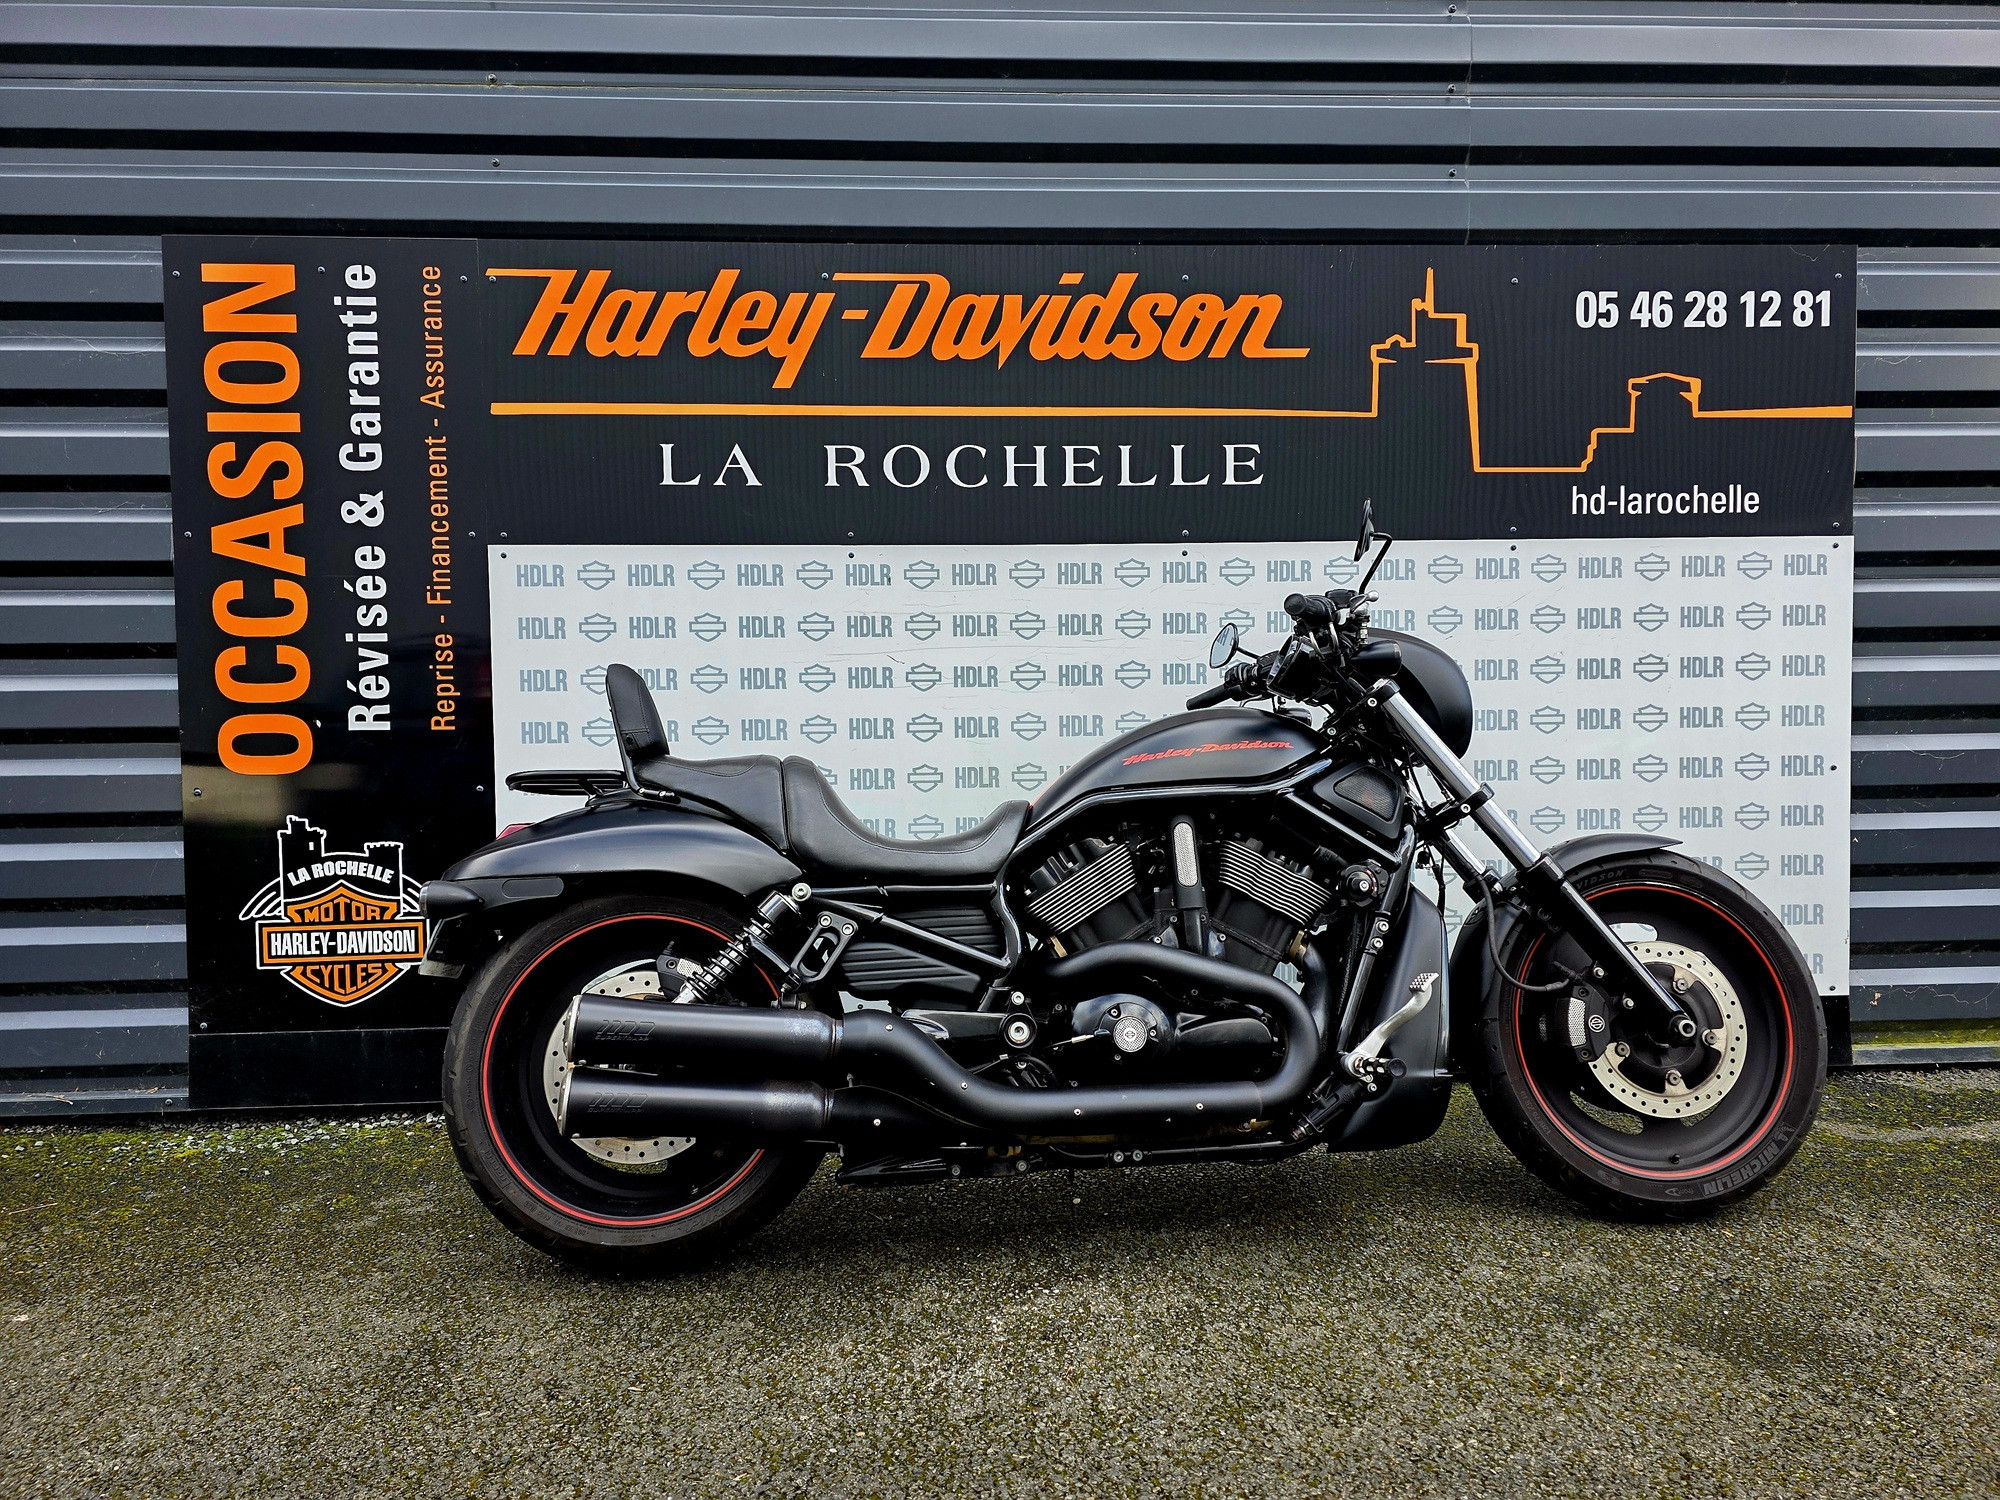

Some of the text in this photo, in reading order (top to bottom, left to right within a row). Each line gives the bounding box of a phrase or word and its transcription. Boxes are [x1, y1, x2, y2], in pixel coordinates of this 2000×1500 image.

[1575, 289, 1832, 329] 05 46 28 12 81
[419, 265, 445, 409] Assurance
[486, 269, 1309, 388] Harley-Davidson
[659, 443, 1264, 488] LA ROCHELLE
[334, 263, 391, 732] Révisée & Garantie
[1571, 484, 1760, 516] hd-larochelle
[201, 264, 313, 775] OCCASION
[423, 435, 452, 606] Financement
[517, 564, 564, 588] HDLR
[628, 564, 675, 586] HDLR
[737, 564, 784, 586] HDLR
[846, 564, 891, 587] HDLR
[952, 564, 997, 585] HDLR
[1058, 563, 1102, 585] HDLR
[1163, 561, 1207, 583] HDLR
[1267, 560, 1311, 582] HDLR
[1476, 558, 1520, 580] HDLR
[1578, 557, 1622, 579] HDLR
[1682, 556, 1725, 578] HDLR
[1784, 555, 1827, 577] HDLR
[518, 617, 566, 639] HDLR
[629, 616, 676, 639] HDLR
[739, 616, 785, 638] HDLR
[847, 616, 893, 638] HDLR
[953, 615, 998, 637] HDLR
[1058, 614, 1103, 636] HDLR
[1163, 612, 1207, 634] HDLR
[1267, 611, 1295, 634] HD
[1475, 608, 1519, 630] HDLR
[1577, 607, 1621, 629] HDLR
[1680, 606, 1724, 628] HDLR
[1783, 605, 1826, 627] HDLR
[430, 633, 460, 731] Reprise
[520, 655, 1825, 692] HDLR DLR HDLR HDLR HDLR HDLR HDLR HDLR HDLR HDLR HDLR
[521, 705, 1825, 744] HDLR HDLR HDLR HDLR HDLR HDLR HDLR HDLR HDLR
[1122, 740, 1294, 766] Harley-Davidson
[850, 755, 1825, 790] HDLR HDLR HDLR HDLR HDLR HDLR
[1577, 808, 1621, 830] HDLR
[1679, 806, 1723, 828] HDLR
[1781, 805, 1824, 827] HDLR
[286, 860, 395, 887] LA ROCHELLE
[1577, 869, 1624, 889] VIDSON
[1781, 854, 1824, 876] HDLR
[303, 895, 382, 923] MOTOR
[1781, 903, 1824, 926] HDLR
[270, 929, 416, 957] HARLEY-DAVIDSON
[305, 963, 383, 995] CYCLES
[1703, 1139, 1781, 1197] MICHELIN
